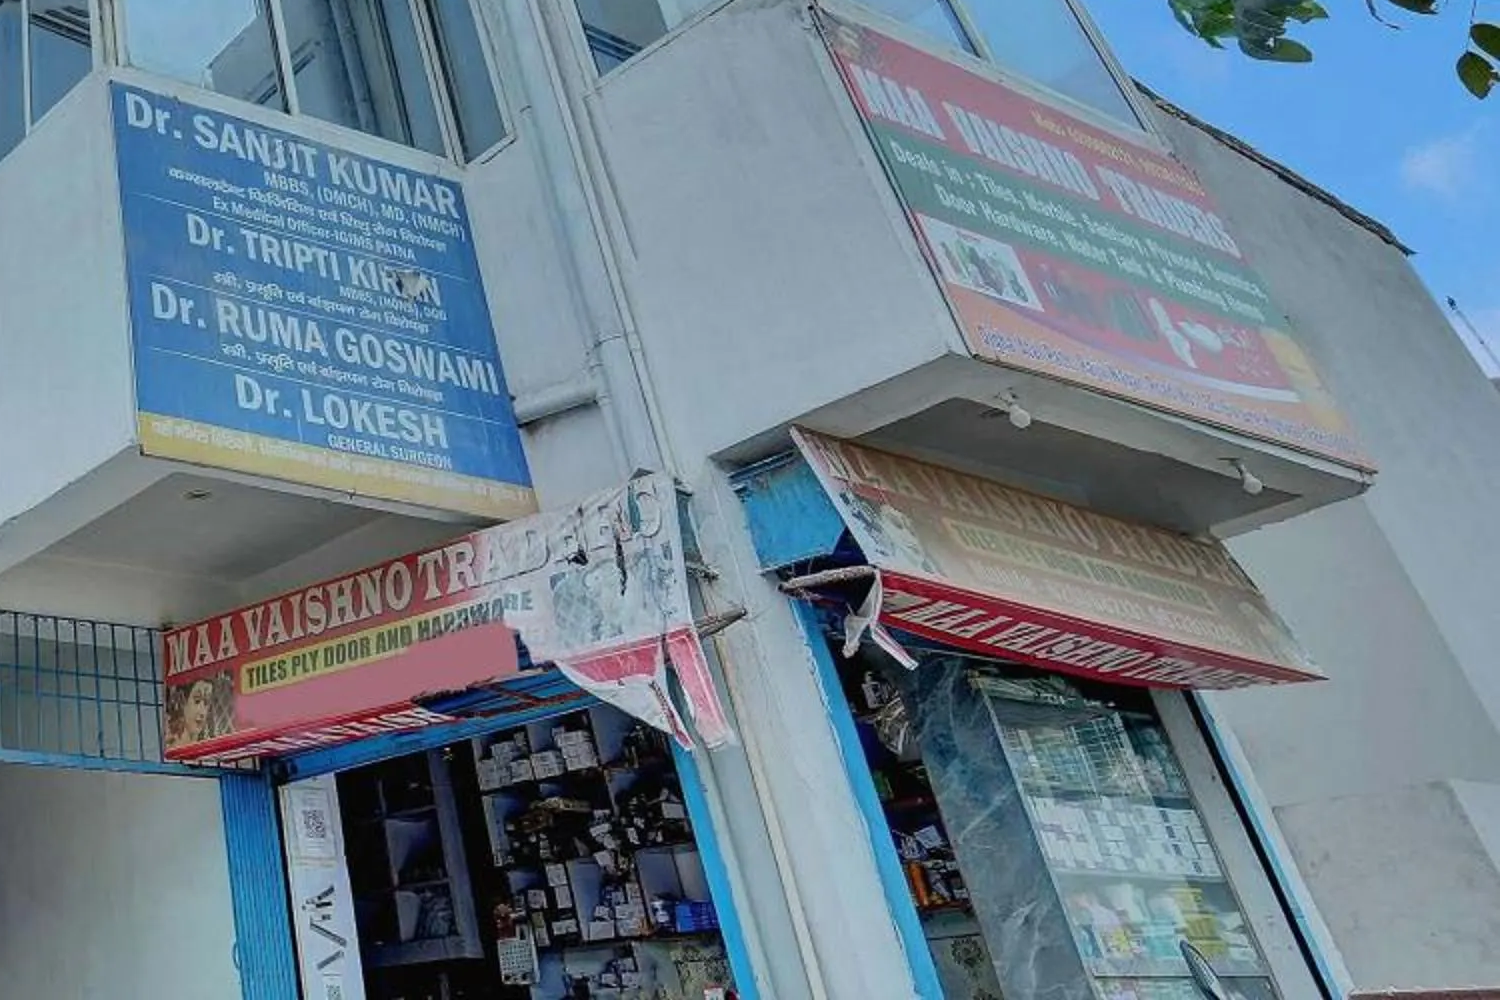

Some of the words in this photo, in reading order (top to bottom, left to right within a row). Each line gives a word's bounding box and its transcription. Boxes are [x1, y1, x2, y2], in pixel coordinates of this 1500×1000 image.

[850, 63, 947, 141] MAA
[125, 92, 182, 139] Dr.
[193, 115, 318, 179] SANJIT
[327, 152, 461, 220] KUMAR
[213, 195, 230, 211] Ex
[186, 213, 234, 256] Dr.
[239, 229, 341, 281] TRIPTI
[347, 255, 442, 307] KIRN
[151, 282, 206, 329] Dr.
[214, 298, 328, 356] RUMA
[334, 327, 501, 396] GOSWAMI
[235, 373, 292, 419] Dr.
[302, 389, 450, 451] LOKESH
[327, 434, 389, 459] GENERAL
[391, 446, 453, 471] SURGEON
[166, 616, 240, 677] MAA
[241, 560, 414, 650] VAISHNO
[246, 658, 287, 689] TILES
[290, 650, 320, 678] PLY
[323, 637, 372, 669] DOOR
[375, 625, 414, 654] AND
